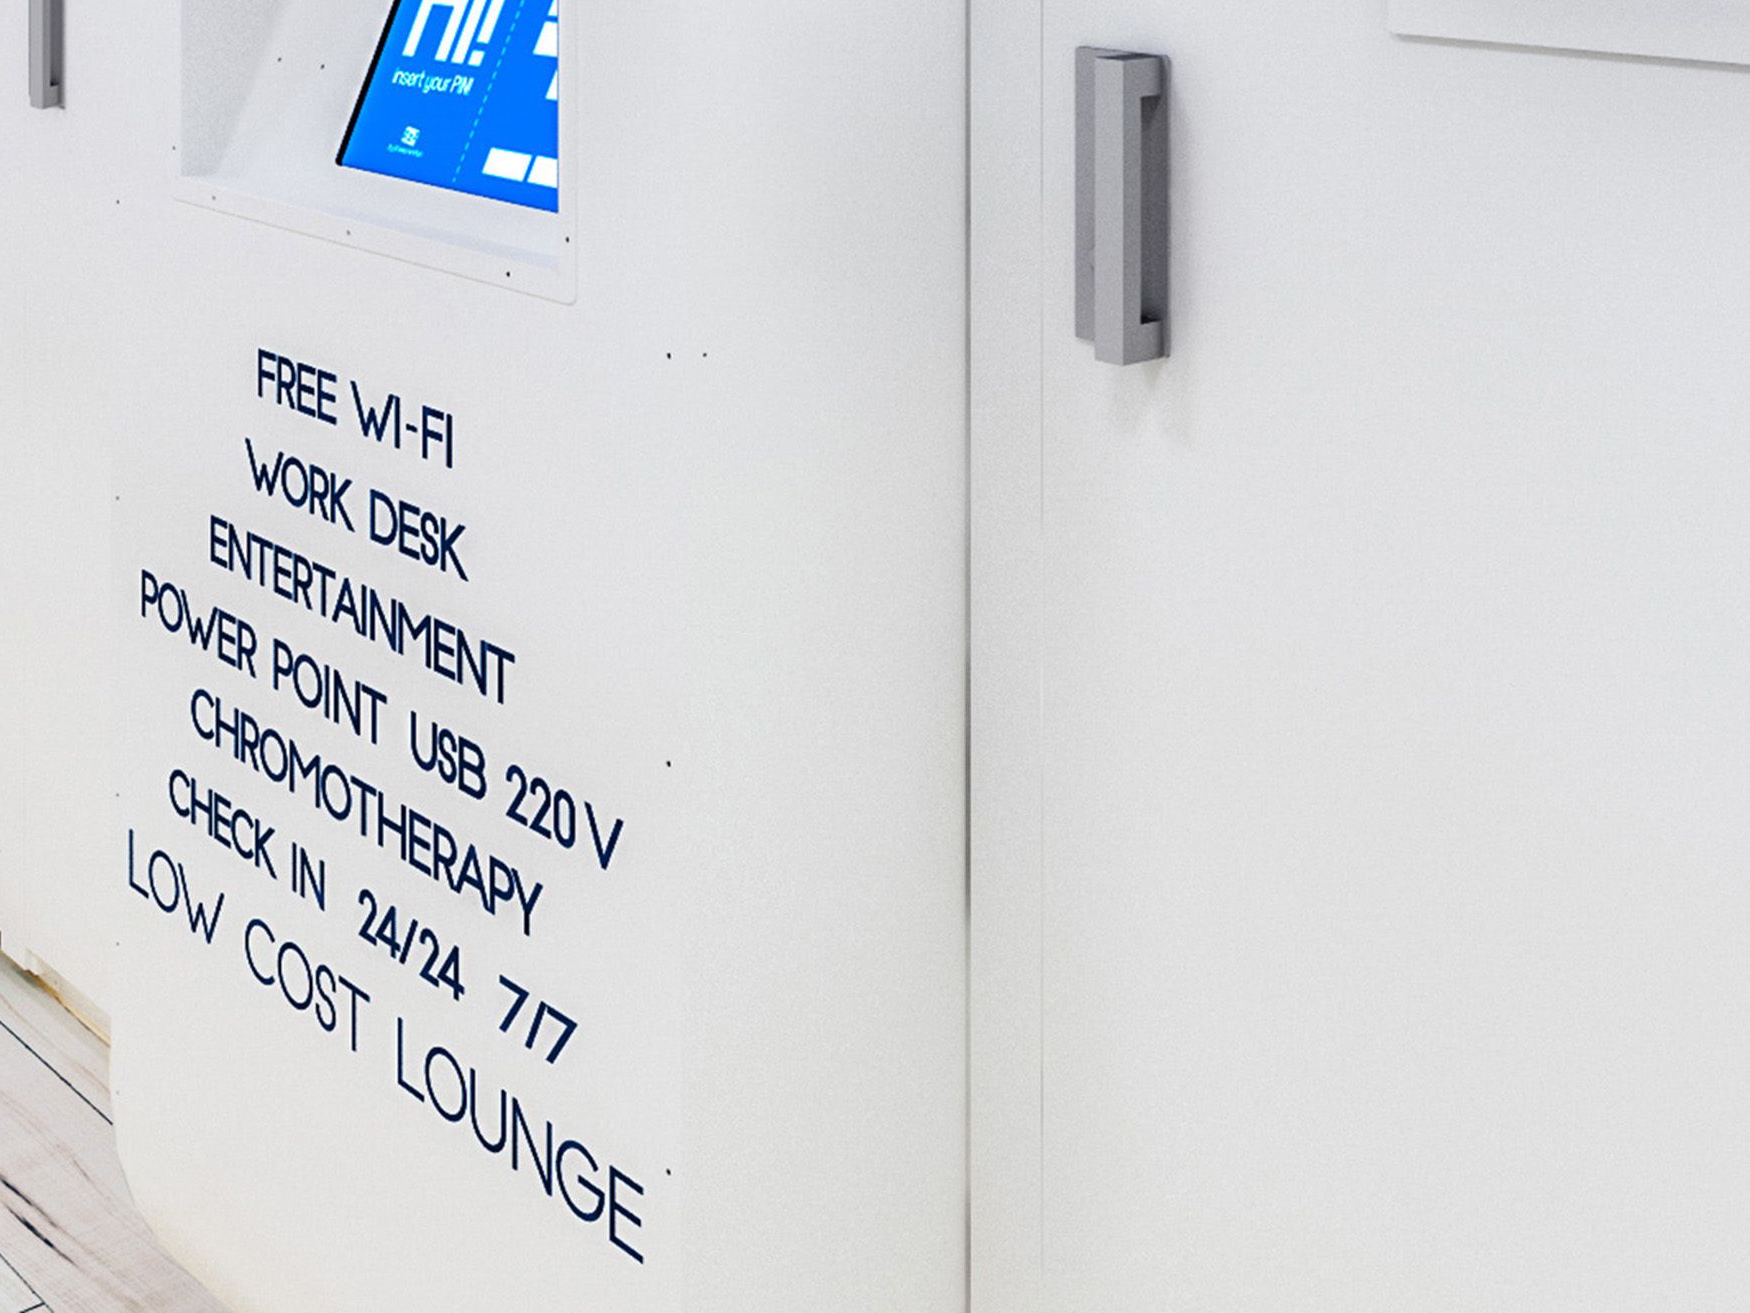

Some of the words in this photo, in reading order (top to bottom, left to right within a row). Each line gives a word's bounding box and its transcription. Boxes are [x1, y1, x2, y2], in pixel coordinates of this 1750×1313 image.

[245, 438, 354, 532] WORK
[370, 489, 468, 581] DESK
[258, 349, 337, 425] FREE
[351, 381, 452, 468] WI-FI
[142, 570, 257, 678] POWER
[273, 639, 387, 742] POINT
[411, 711, 486, 799] USB
[211, 515, 515, 703] ENTERTAINMENT
[169, 771, 277, 879] CHECK
[292, 842, 324, 911] IN
[359, 890, 464, 1000] 24/24
[500, 975, 577, 1062] 7/7
[191, 691, 543, 935] CHROMOTHERAPY
[129, 829, 224, 942] LOW
[245, 919, 370, 1051] COST
[398, 1018, 643, 1264] LOUNGE
